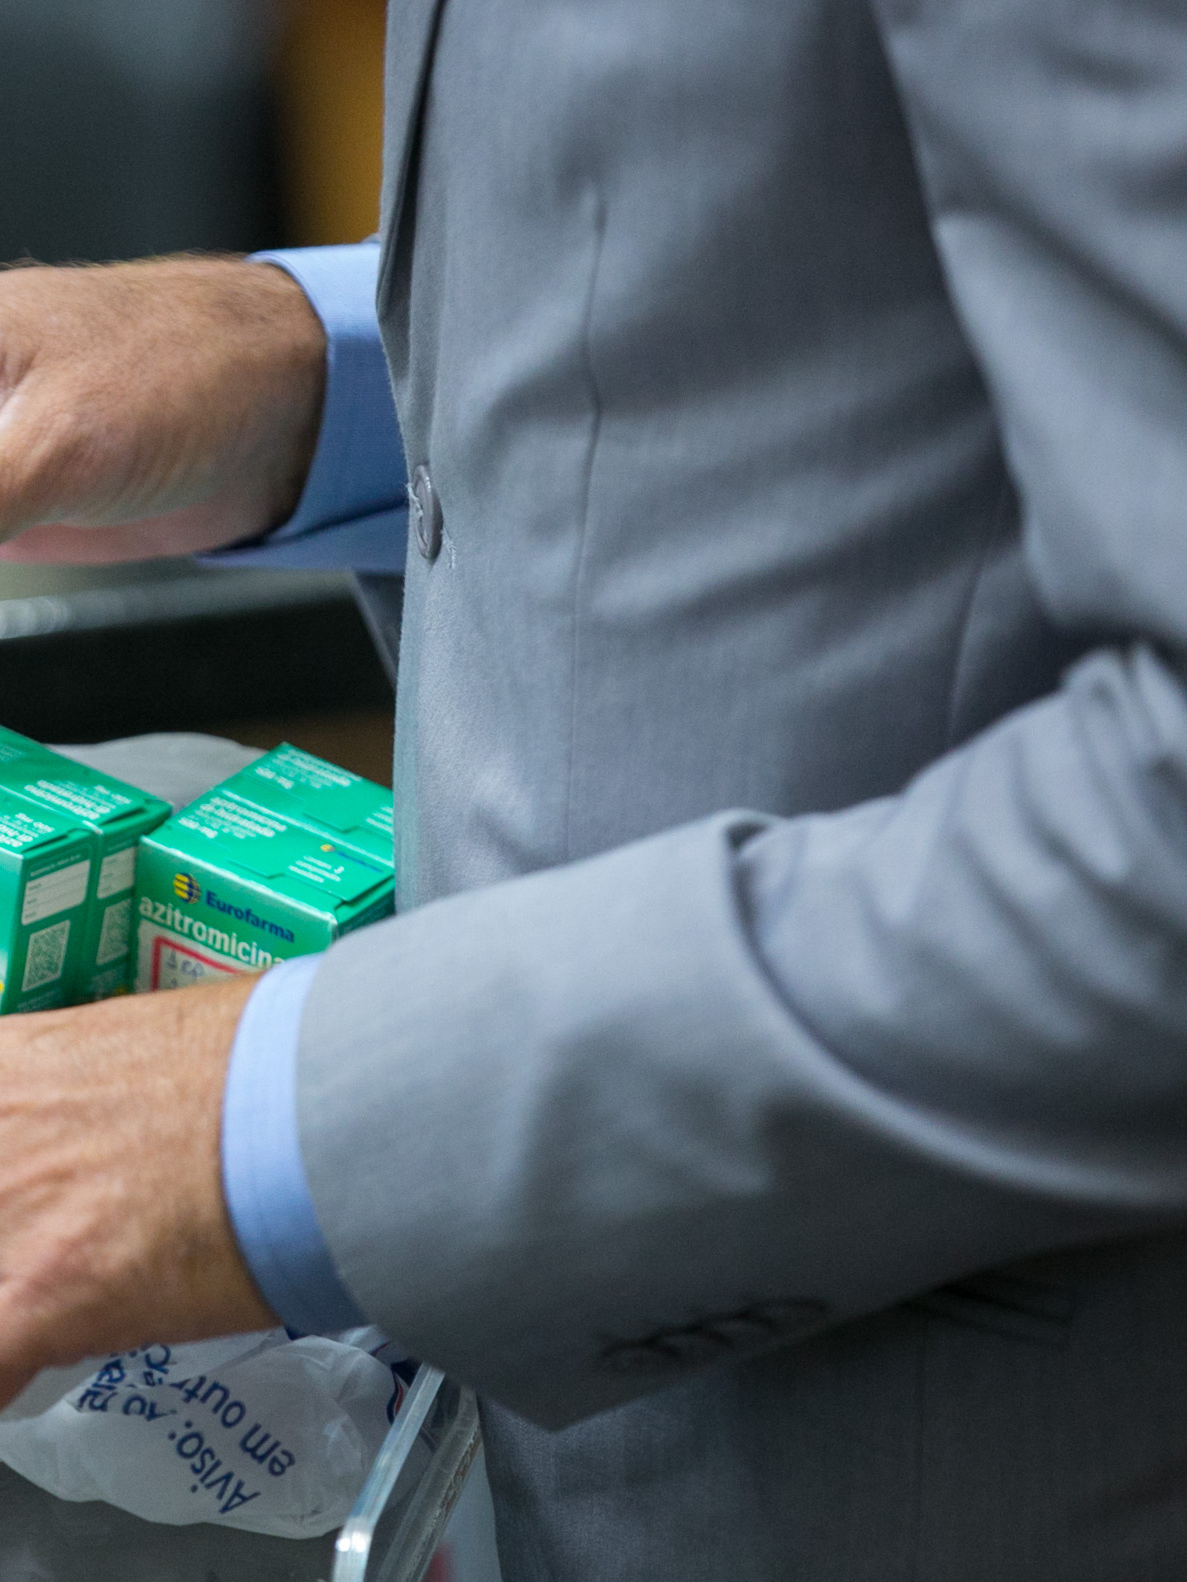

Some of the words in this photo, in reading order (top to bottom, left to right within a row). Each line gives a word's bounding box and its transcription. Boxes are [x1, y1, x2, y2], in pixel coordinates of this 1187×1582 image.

[205, 889, 295, 943] Eurofarma
[167, 1419, 261, 1515] Aviso:
[238, 1422, 296, 1477] em
